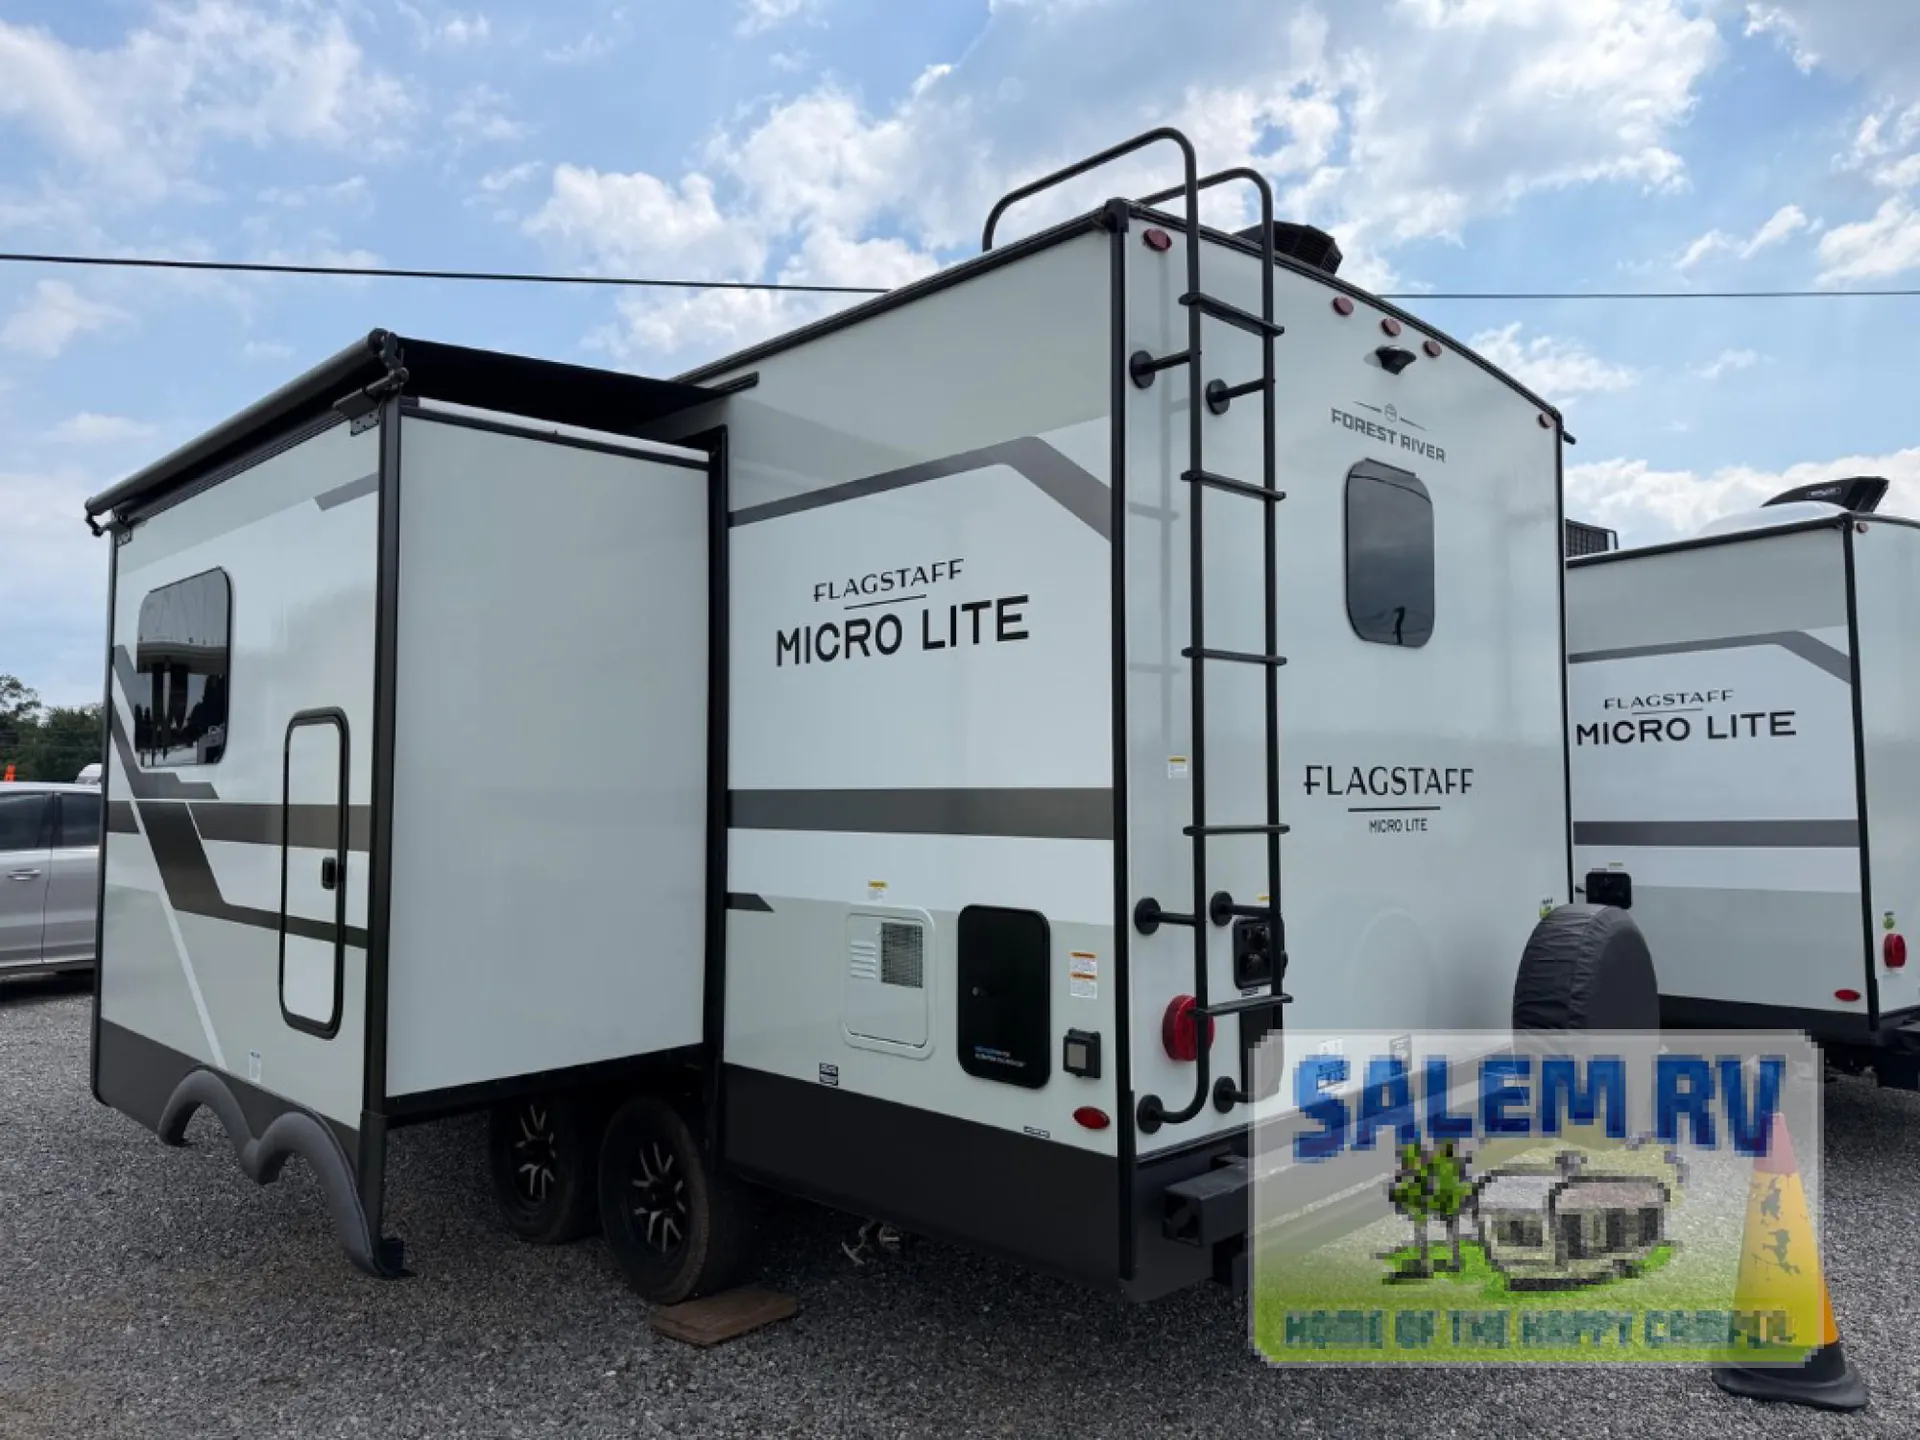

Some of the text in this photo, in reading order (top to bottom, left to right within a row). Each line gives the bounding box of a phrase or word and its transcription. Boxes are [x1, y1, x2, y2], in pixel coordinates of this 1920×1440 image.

[1331, 407, 1446, 464] FOREST RIVER
[813, 557, 965, 603] FLAGSTAFF
[776, 594, 1030, 667] MICRO LITE
[1602, 689, 1734, 710] FLAGSTAFF
[1576, 710, 1797, 746] MICRO LITE
[1303, 764, 1475, 796] FLAGSTAFF
[1368, 817, 1429, 834] MICRO LITE
